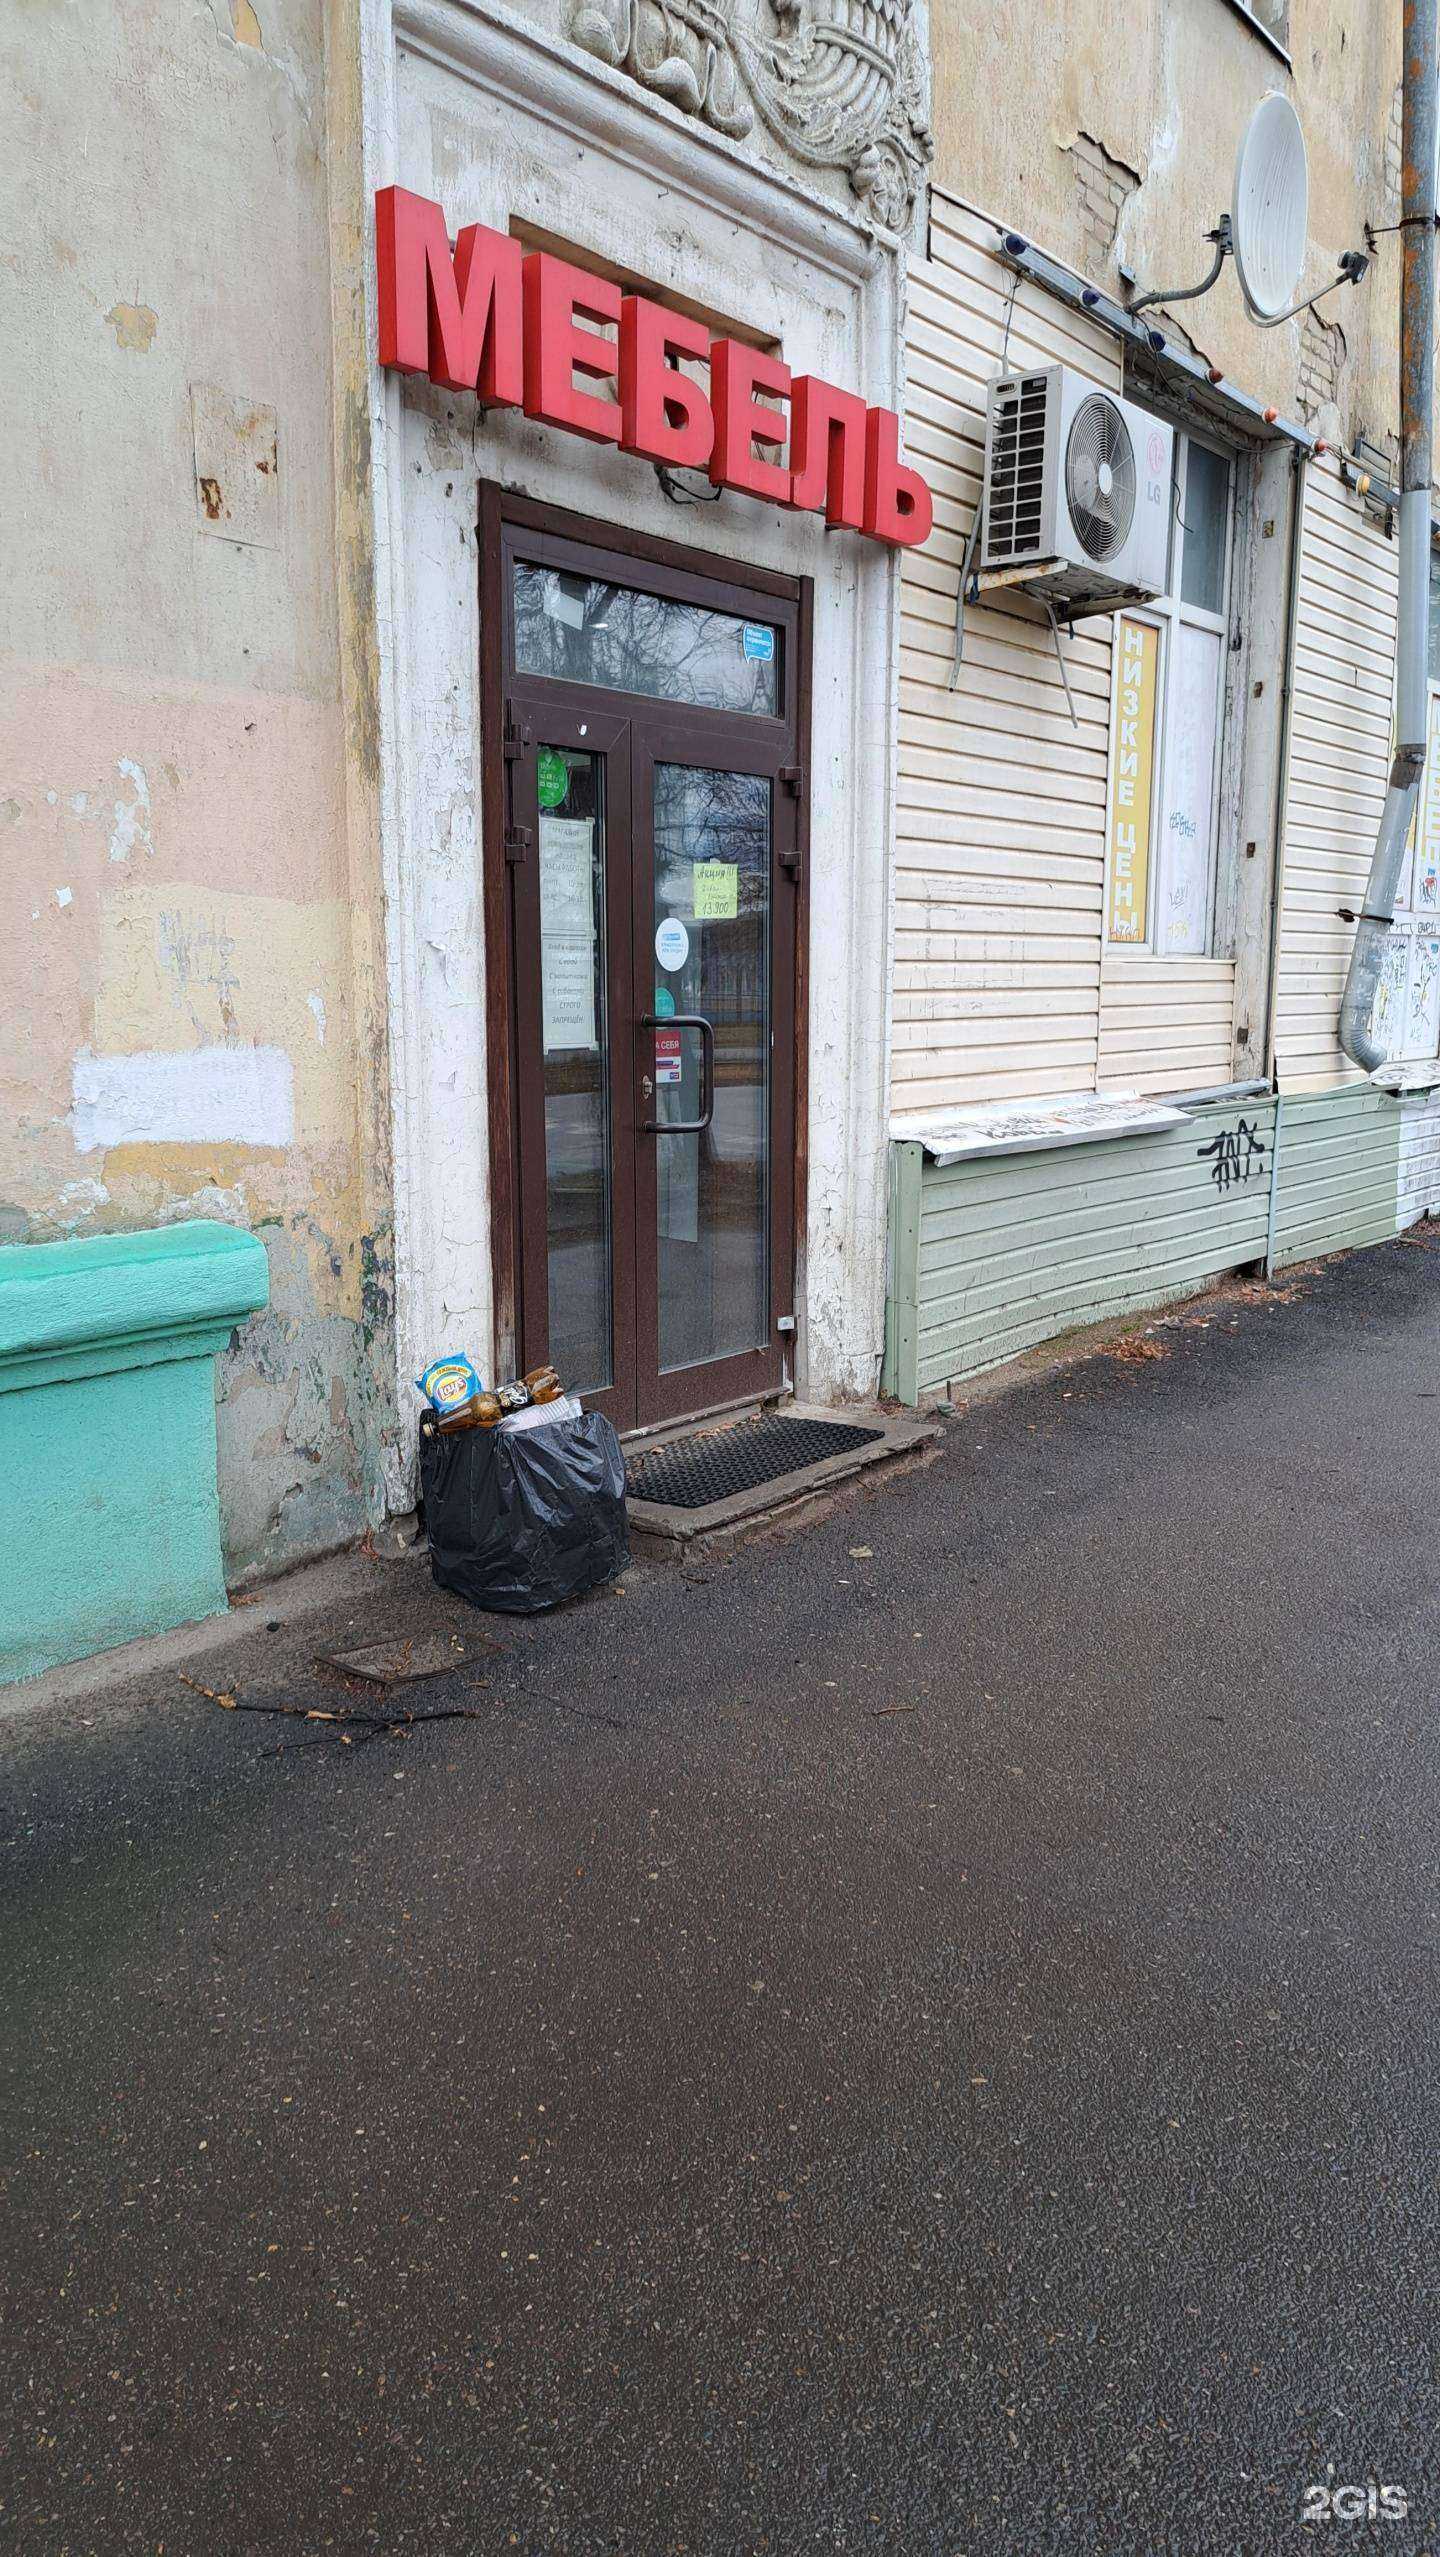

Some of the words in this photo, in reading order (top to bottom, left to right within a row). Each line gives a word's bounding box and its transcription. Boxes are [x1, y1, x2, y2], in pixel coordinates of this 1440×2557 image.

[375, 184, 934, 548] МЕБЕЛЬ
[1146, 480, 1161, 506] LG
[1117, 626, 1144, 807] НИЗКИЕ
[1114, 821, 1139, 936] ЦЕНЫ
[661, 1039, 680, 1050] СЕБЯ
